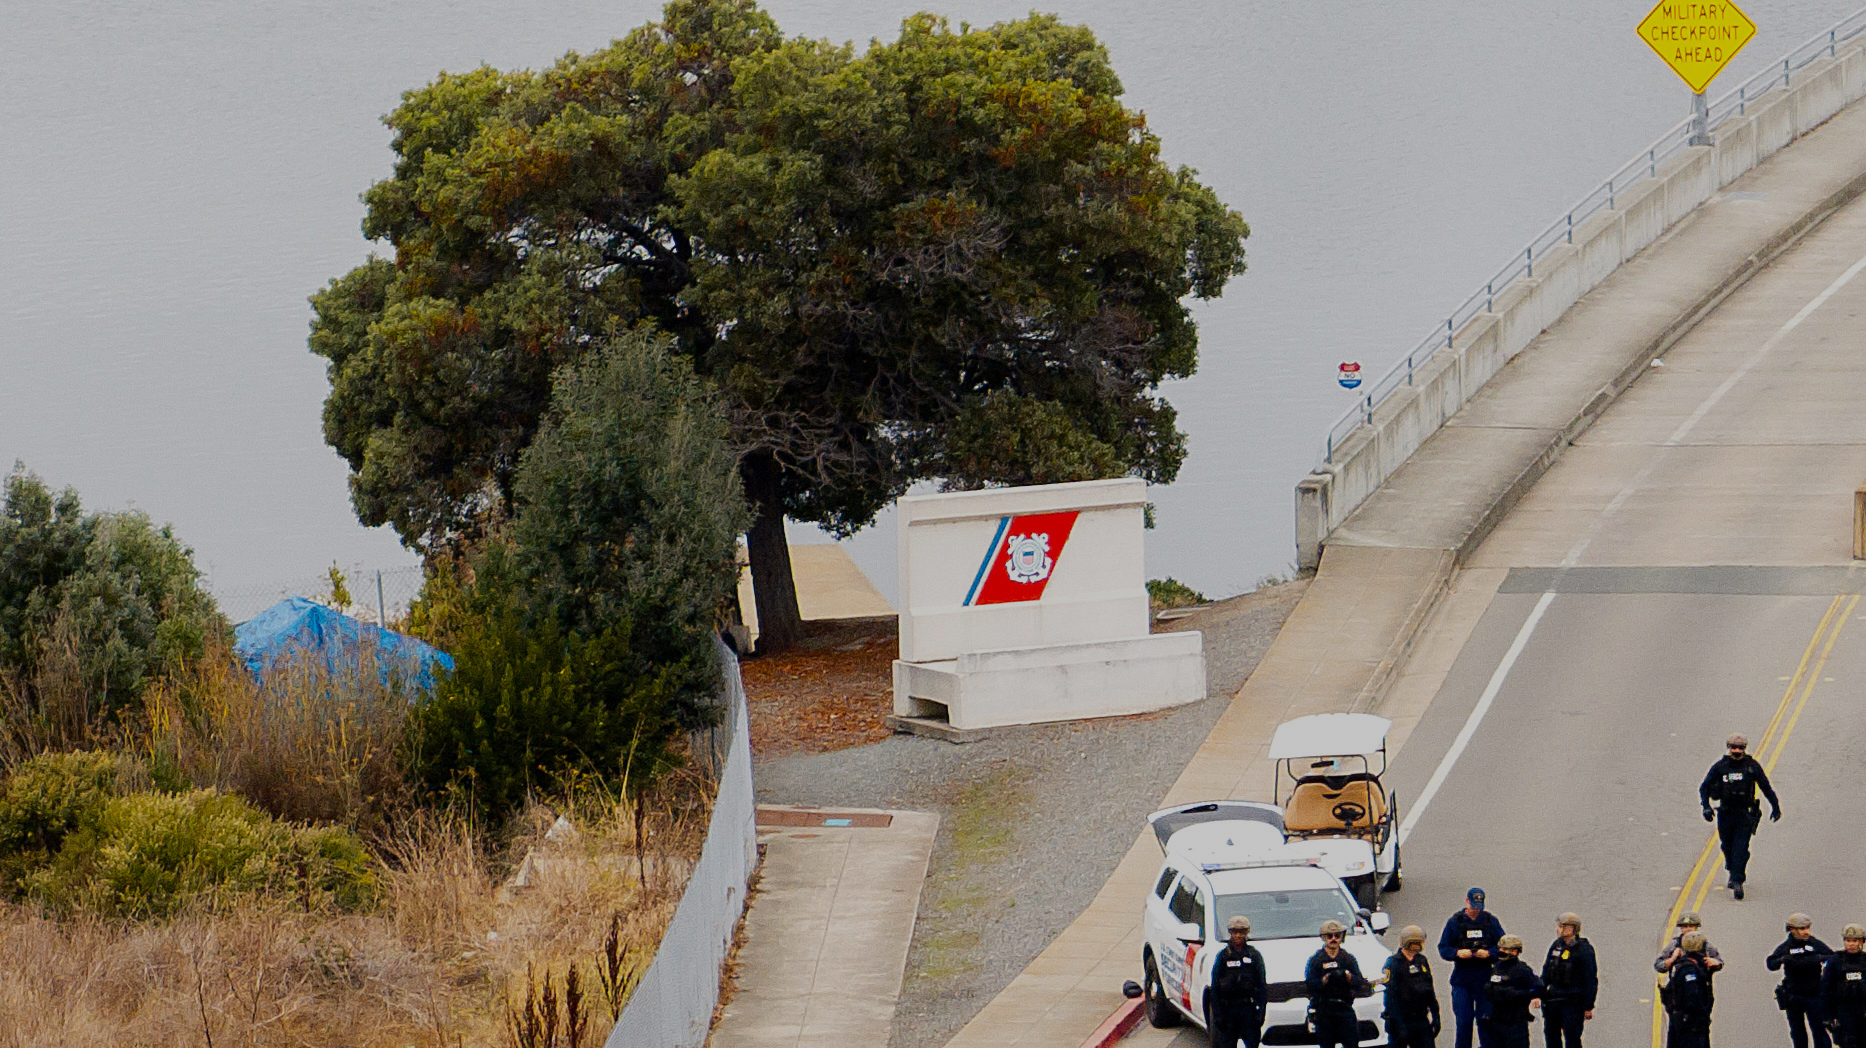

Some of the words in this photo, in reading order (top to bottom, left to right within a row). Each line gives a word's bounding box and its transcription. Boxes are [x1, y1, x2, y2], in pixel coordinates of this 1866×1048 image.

[1662, 4, 1728, 20] MILITARY
[1651, 26, 1739, 41] CHECKPOINT
[1674, 47, 1723, 63] AHEAD
